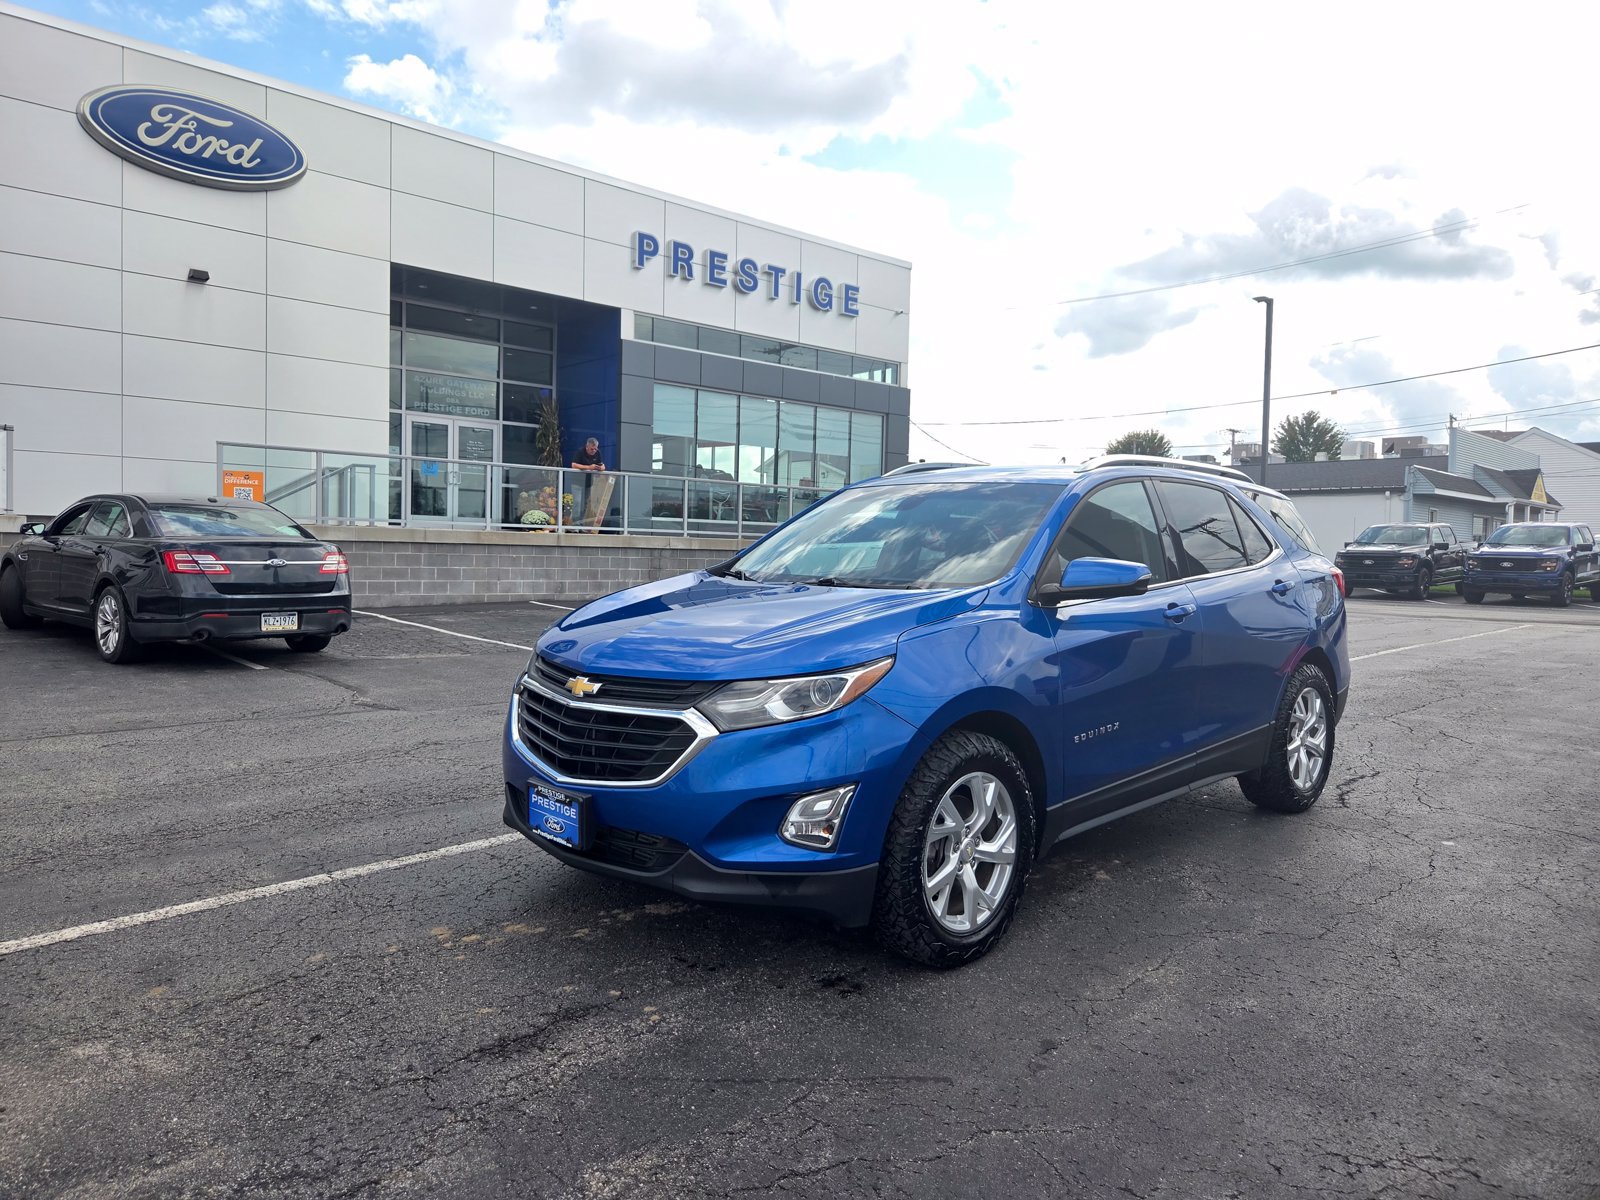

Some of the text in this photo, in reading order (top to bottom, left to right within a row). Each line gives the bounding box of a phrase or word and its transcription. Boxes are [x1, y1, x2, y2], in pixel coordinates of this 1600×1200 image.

[137, 103, 264, 168] Ford
[632, 230, 860, 317] PRESTIGE
[420, 385, 485, 399] HOLDINGS LLC
[414, 401, 490, 416] PRESTIGE FORD
[1074, 721, 1120, 743] EQUINOX
[531, 793, 577, 819] PRESTIGE
[547, 816, 562, 831] Ford
